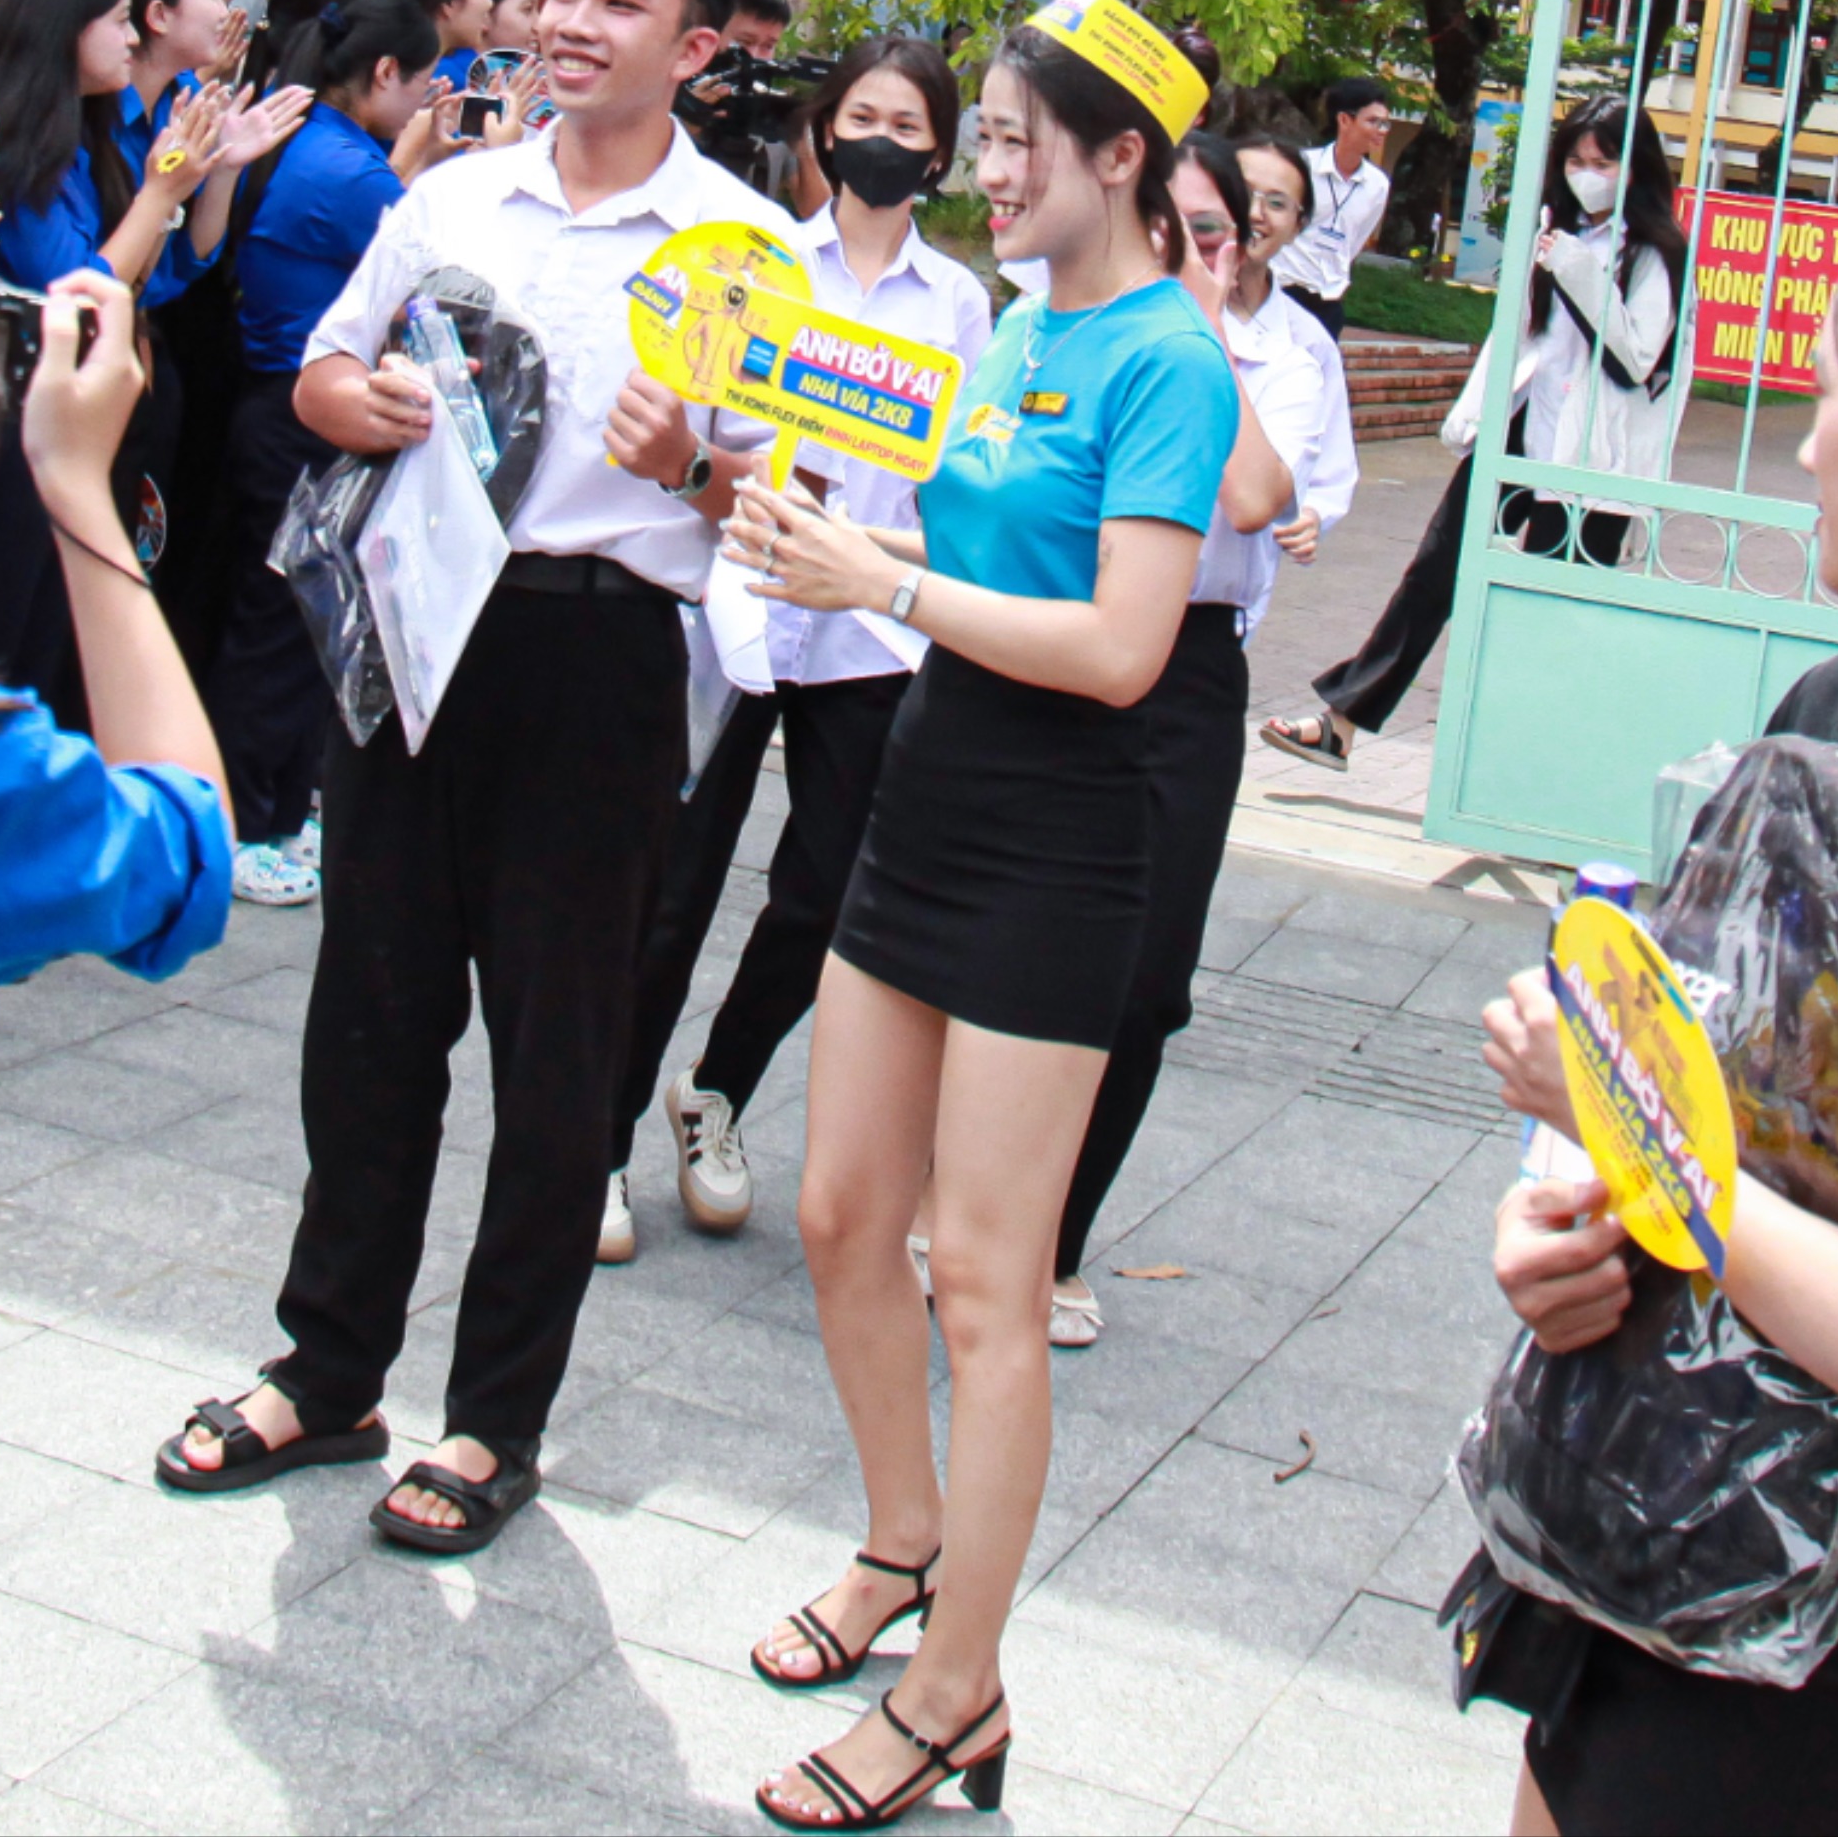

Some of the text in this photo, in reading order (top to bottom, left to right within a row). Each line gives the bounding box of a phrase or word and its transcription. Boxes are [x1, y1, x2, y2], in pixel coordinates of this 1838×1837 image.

[1710, 214, 1767, 255] KHU
[1775, 221, 1825, 268] VỰC
[1696, 261, 1767, 309] HÔNG
[789, 324, 852, 371] ANH
[890, 357, 945, 404] V-AI
[771, 405, 797, 425] FLEX
[851, 433, 895, 461] LAPTOP
[868, 395, 914, 430] 2K8
[1565, 960, 1623, 1062] ANH
[1642, 1136, 1694, 1219] 2K8
